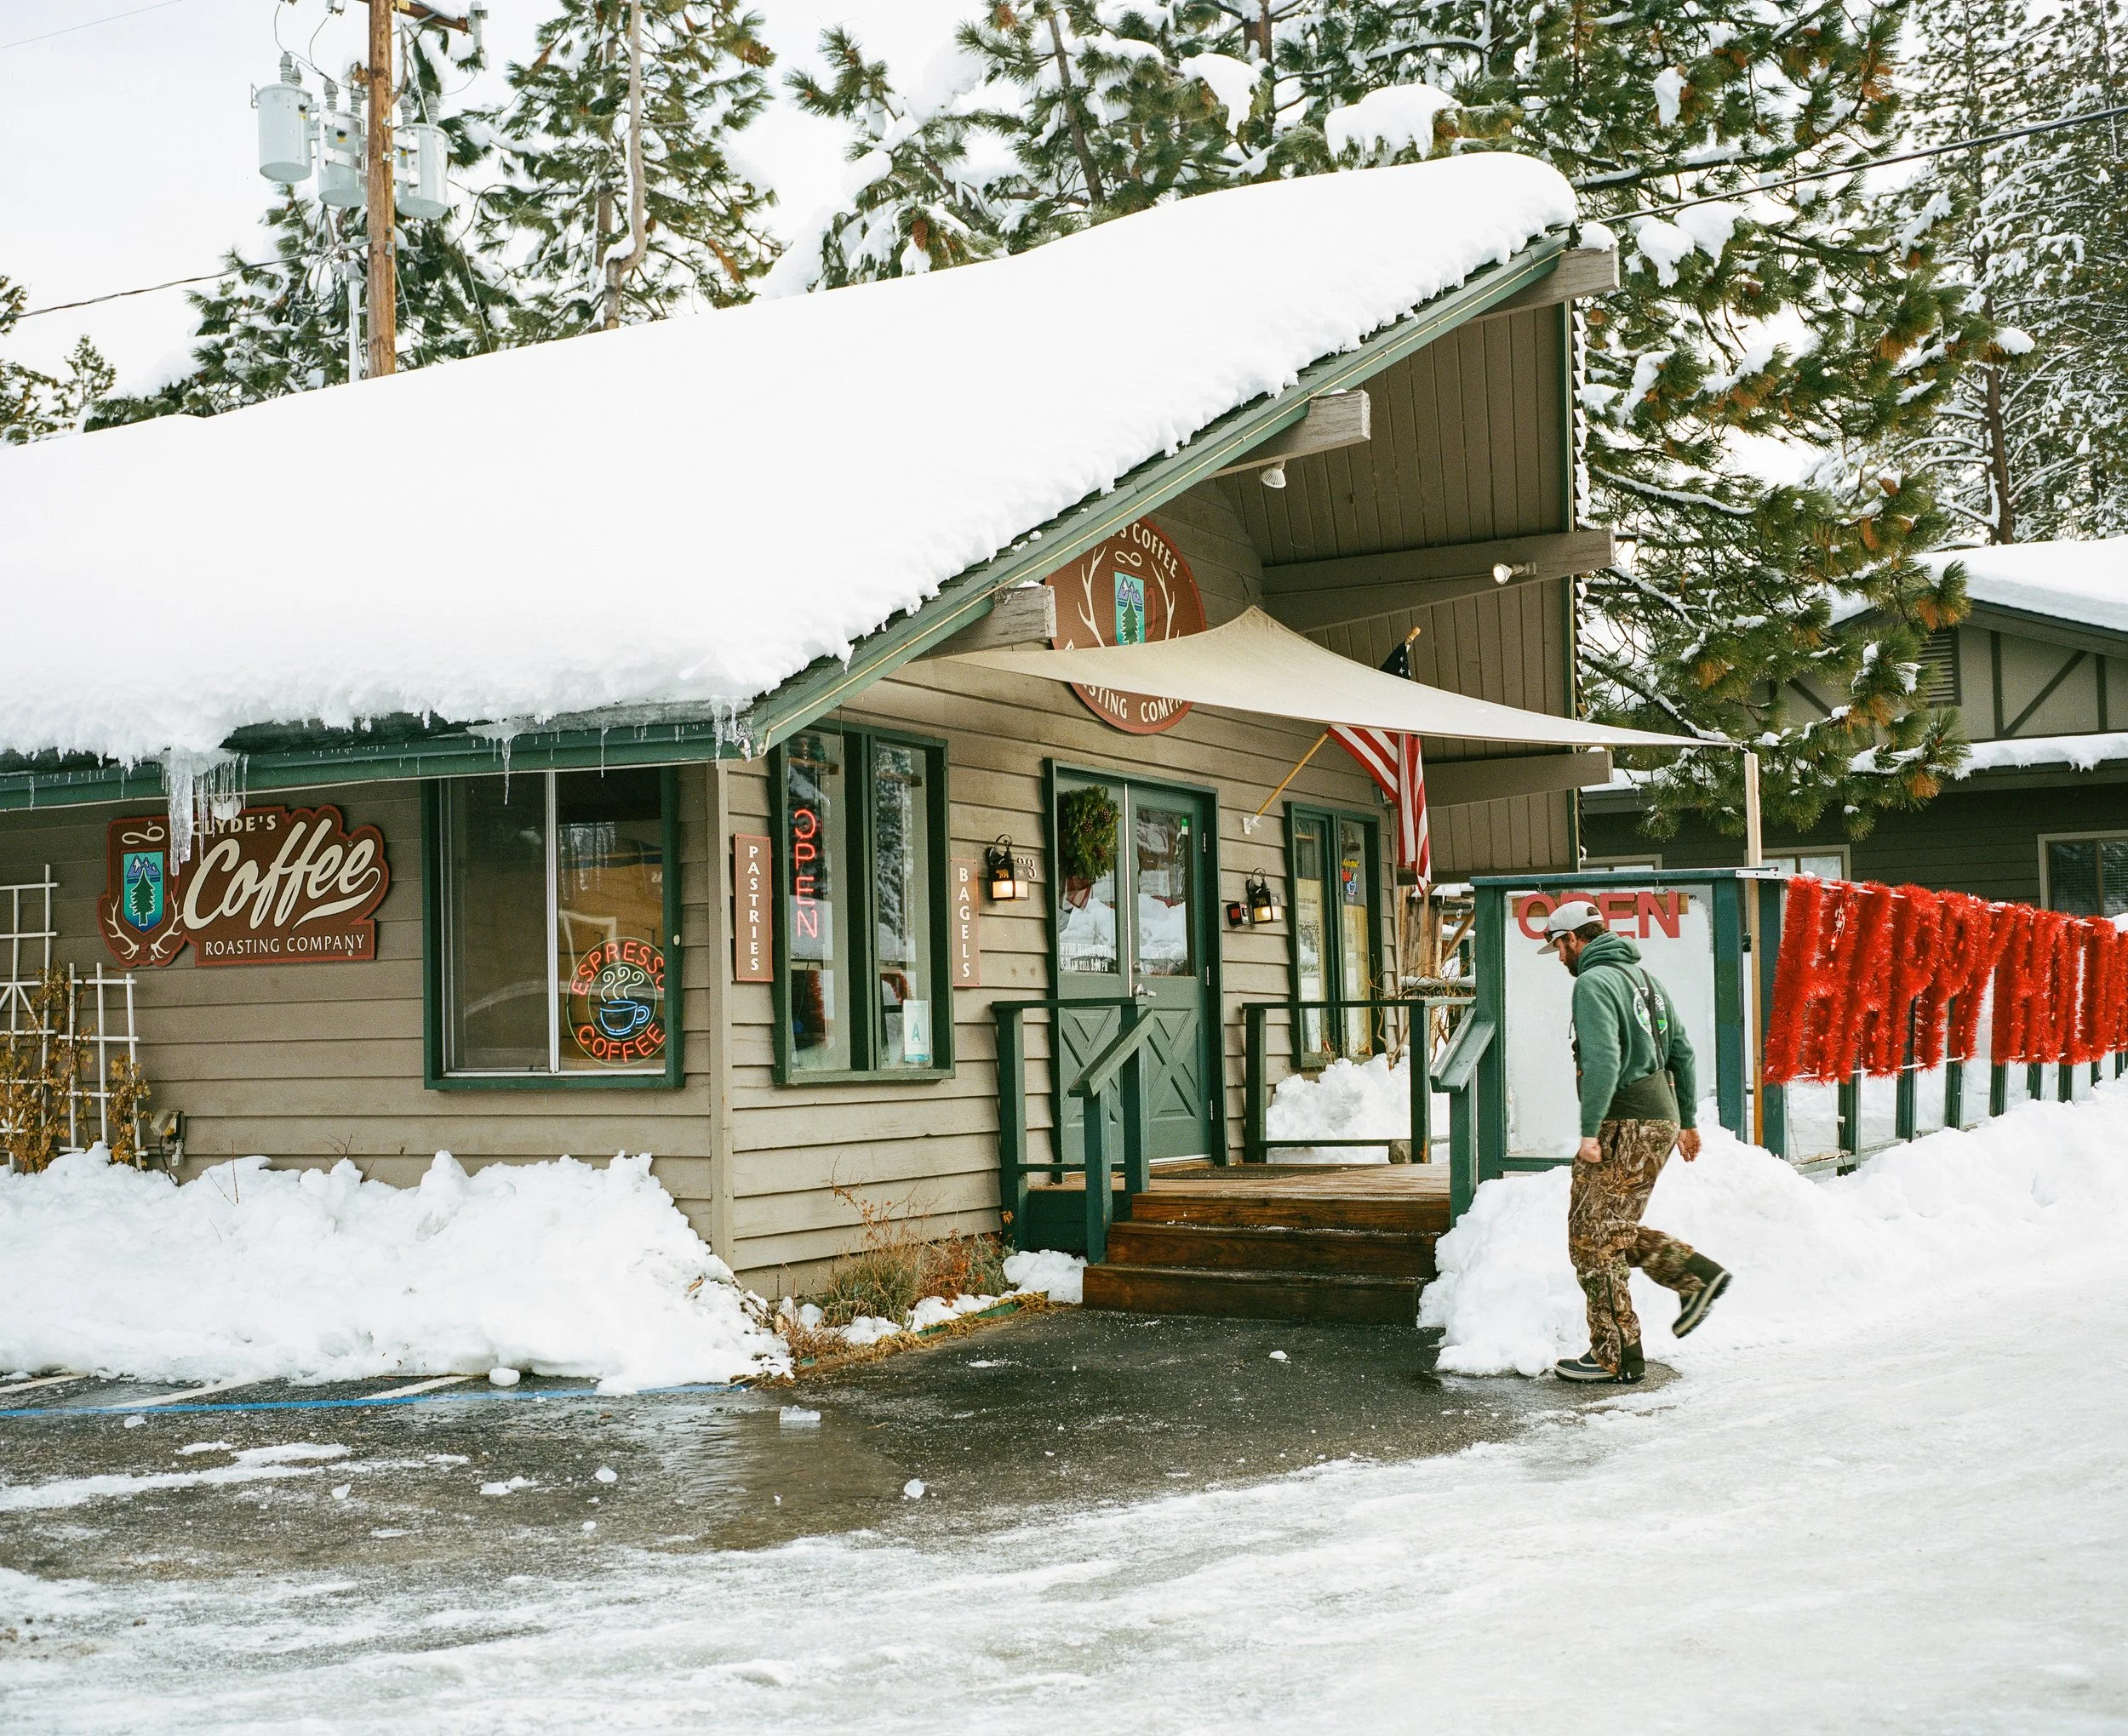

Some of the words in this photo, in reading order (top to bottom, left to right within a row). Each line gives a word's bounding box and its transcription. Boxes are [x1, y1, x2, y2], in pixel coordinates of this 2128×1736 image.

[1132, 523, 1178, 578] COFFEE
[1084, 684, 1127, 719] STING
[183, 818, 380, 930] Coffee
[794, 808, 818, 939] OPEN
[747, 845, 761, 972] PASTRIES
[958, 867, 971, 979] BAGELS
[1518, 890, 1681, 939] OEN
[205, 937, 279, 956] ROASTING
[287, 934, 365, 952] COMPANY
[579, 1023, 666, 1063] COFFEE
[912, 1022, 921, 1042] A
